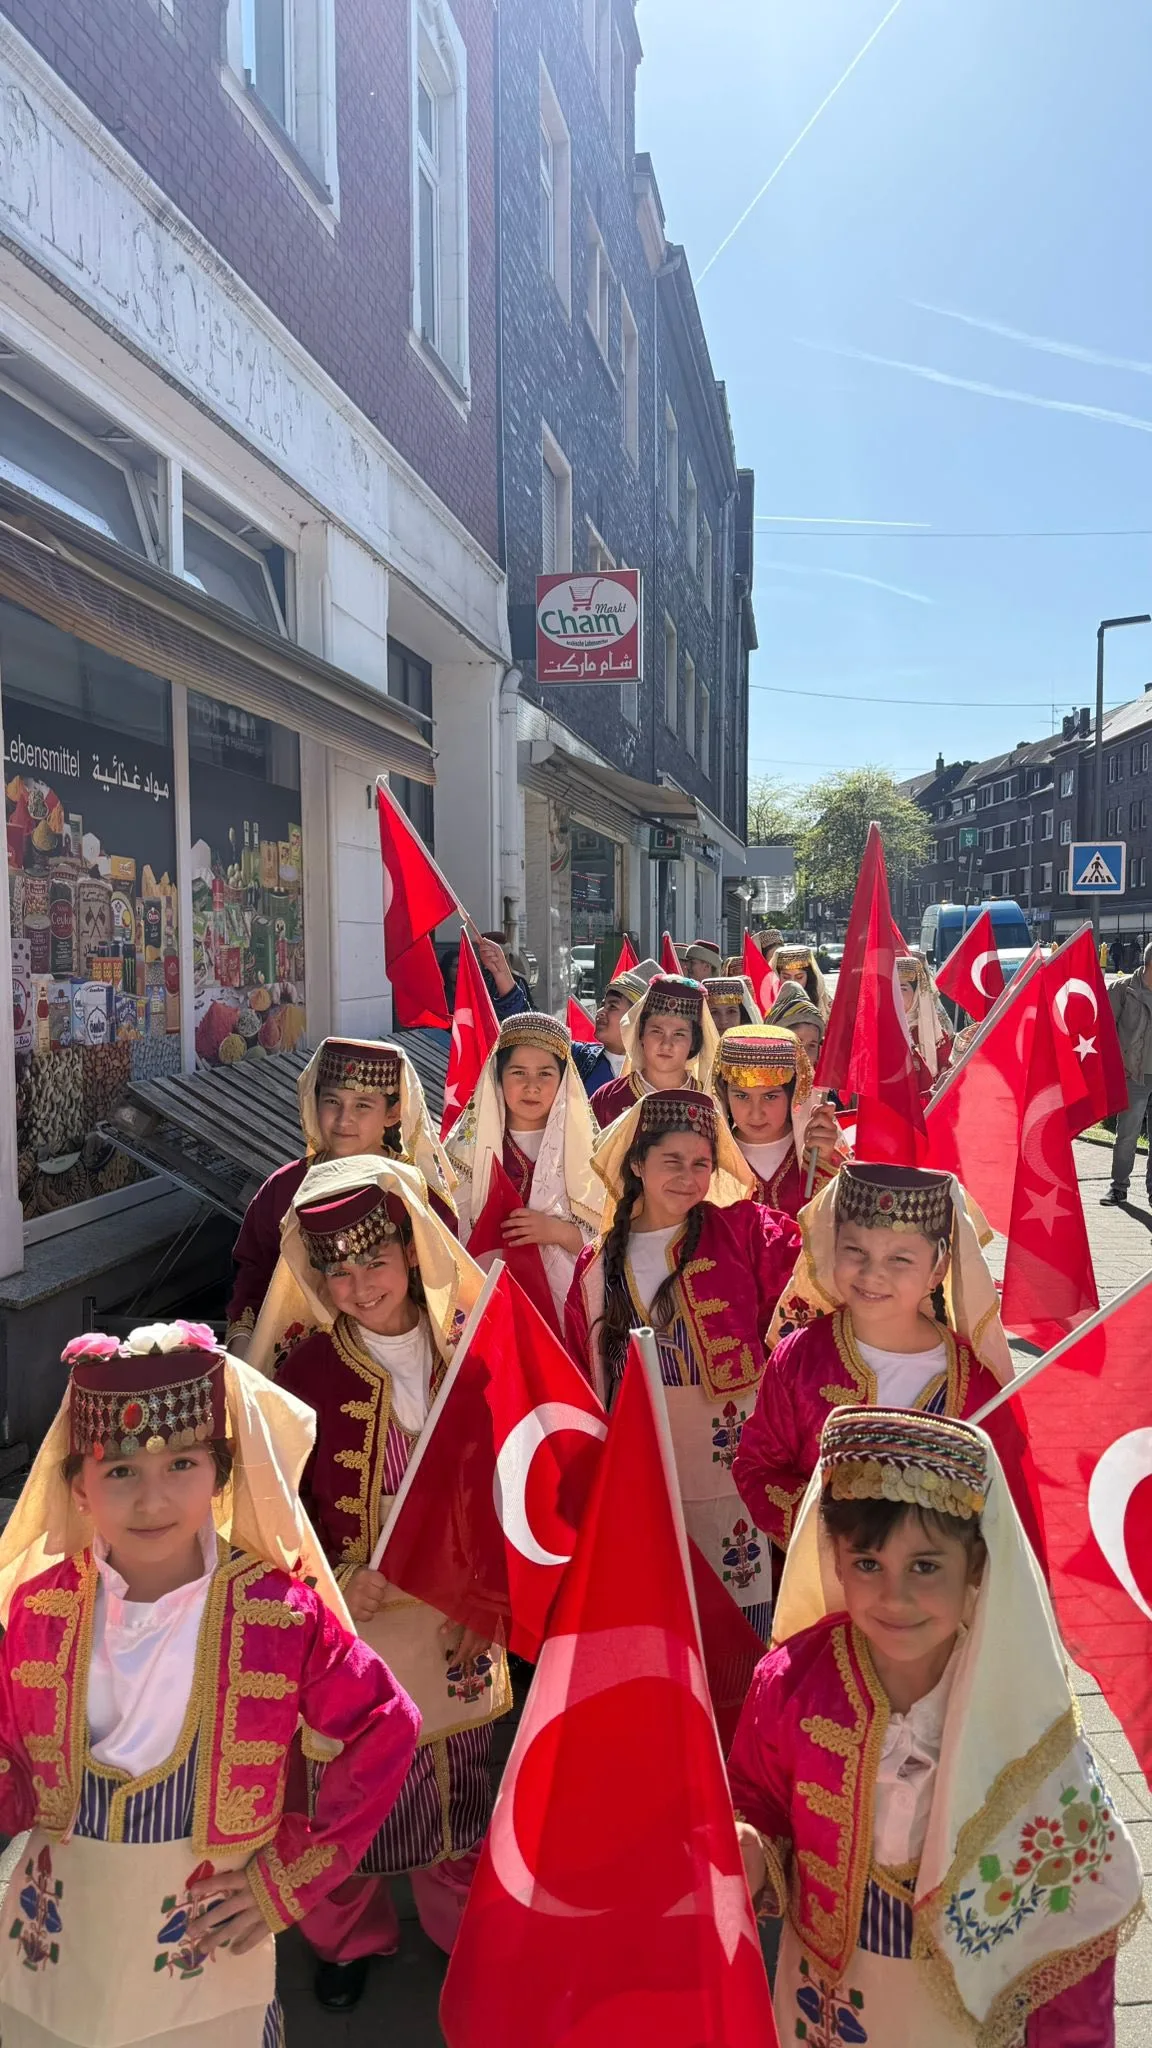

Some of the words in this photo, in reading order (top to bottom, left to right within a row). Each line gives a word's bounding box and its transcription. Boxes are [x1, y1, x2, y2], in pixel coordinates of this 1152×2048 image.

[595, 603, 627, 614] Markt
[541, 609, 624, 636] Cham
[544, 652, 597, 677] ماركت
[600, 651, 633, 676] شام
[92, 753, 141, 793] غذائية
[143, 772, 170, 802] مواد
